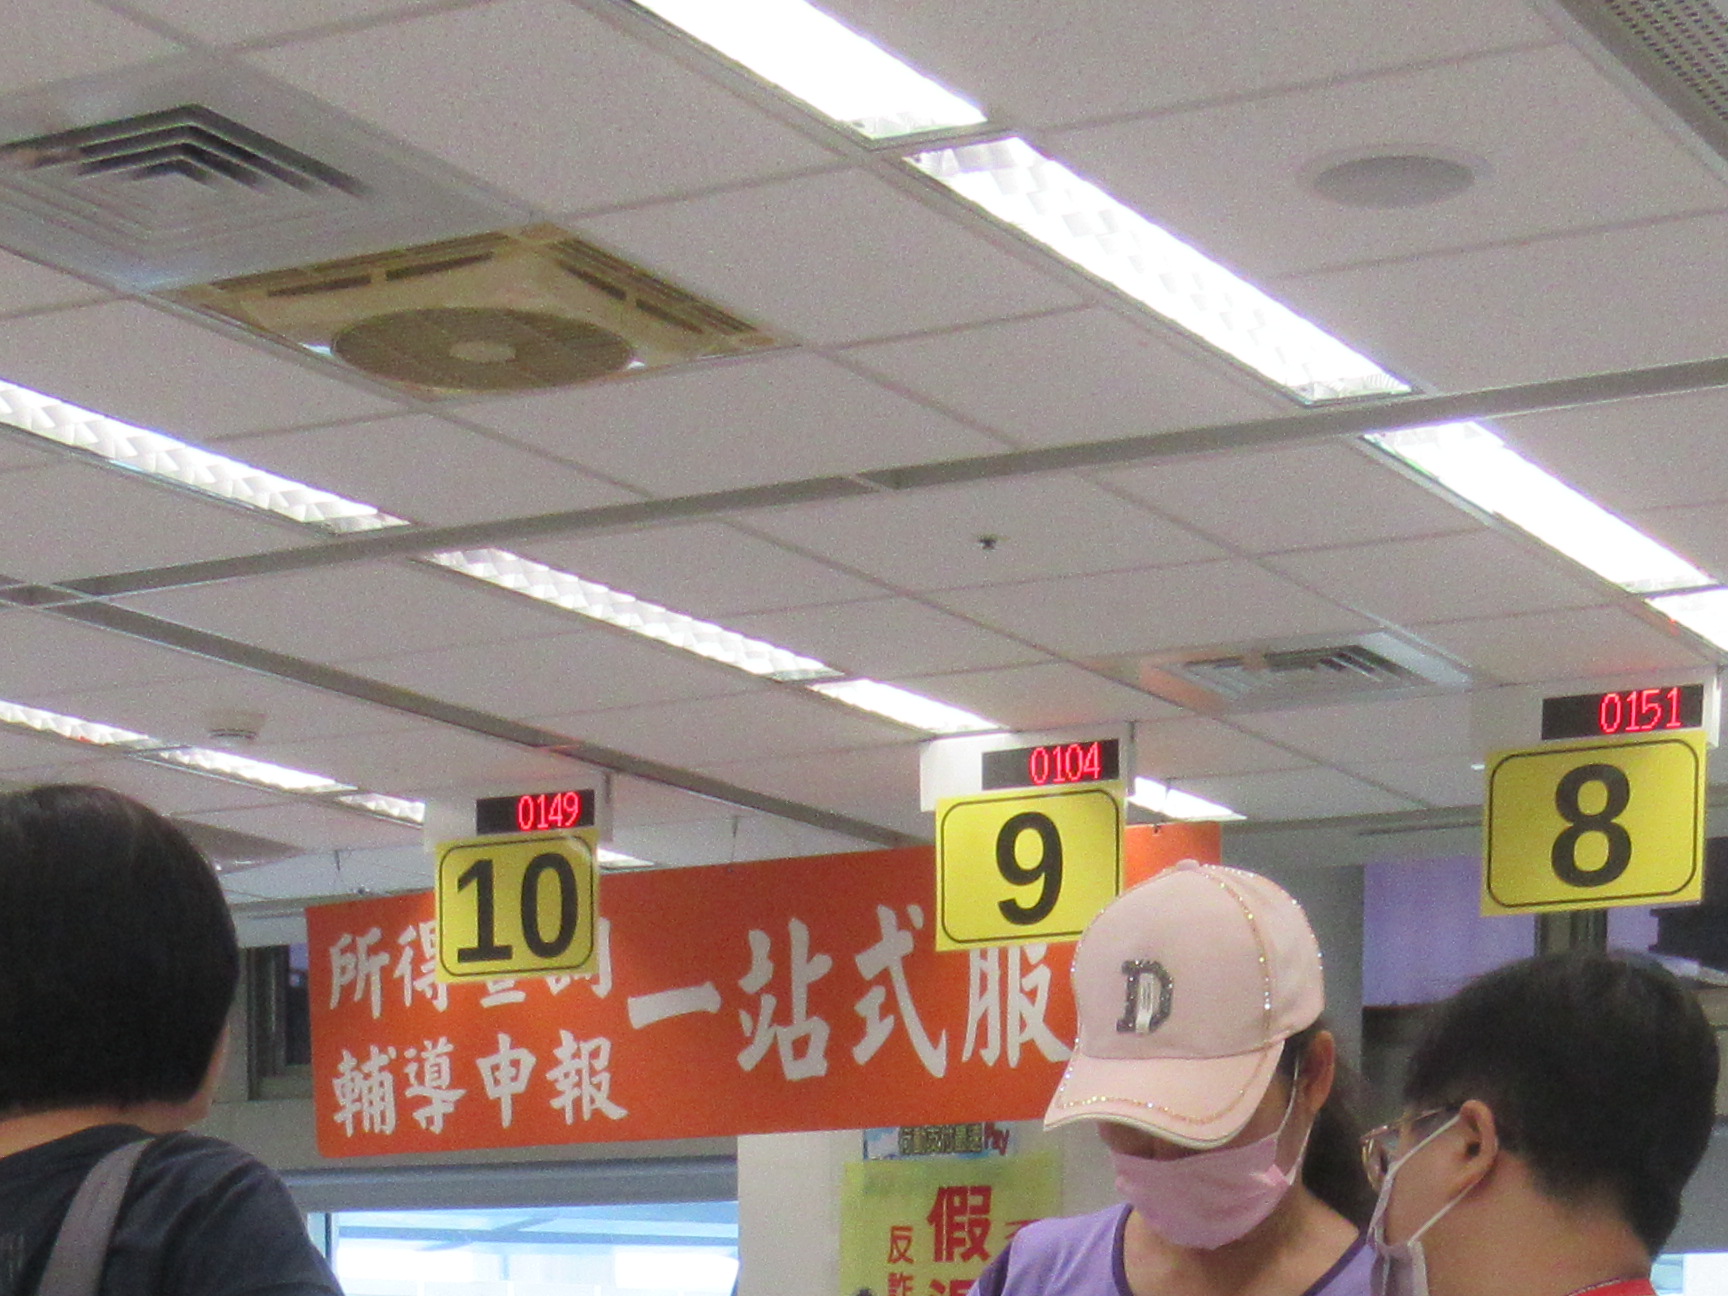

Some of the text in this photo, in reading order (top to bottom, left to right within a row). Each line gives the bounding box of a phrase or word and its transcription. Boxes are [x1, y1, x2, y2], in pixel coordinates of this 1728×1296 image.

[1598, 687, 1683, 735] 0151
[1029, 741, 1101, 785] 0104
[517, 792, 583, 831] 0149
[1549, 763, 1633, 888] 8
[455, 849, 579, 963] 10
[994, 810, 1064, 926] 9
[1116, 959, 1173, 1035] D
[331, 1028, 630, 1138] 輔導申報
